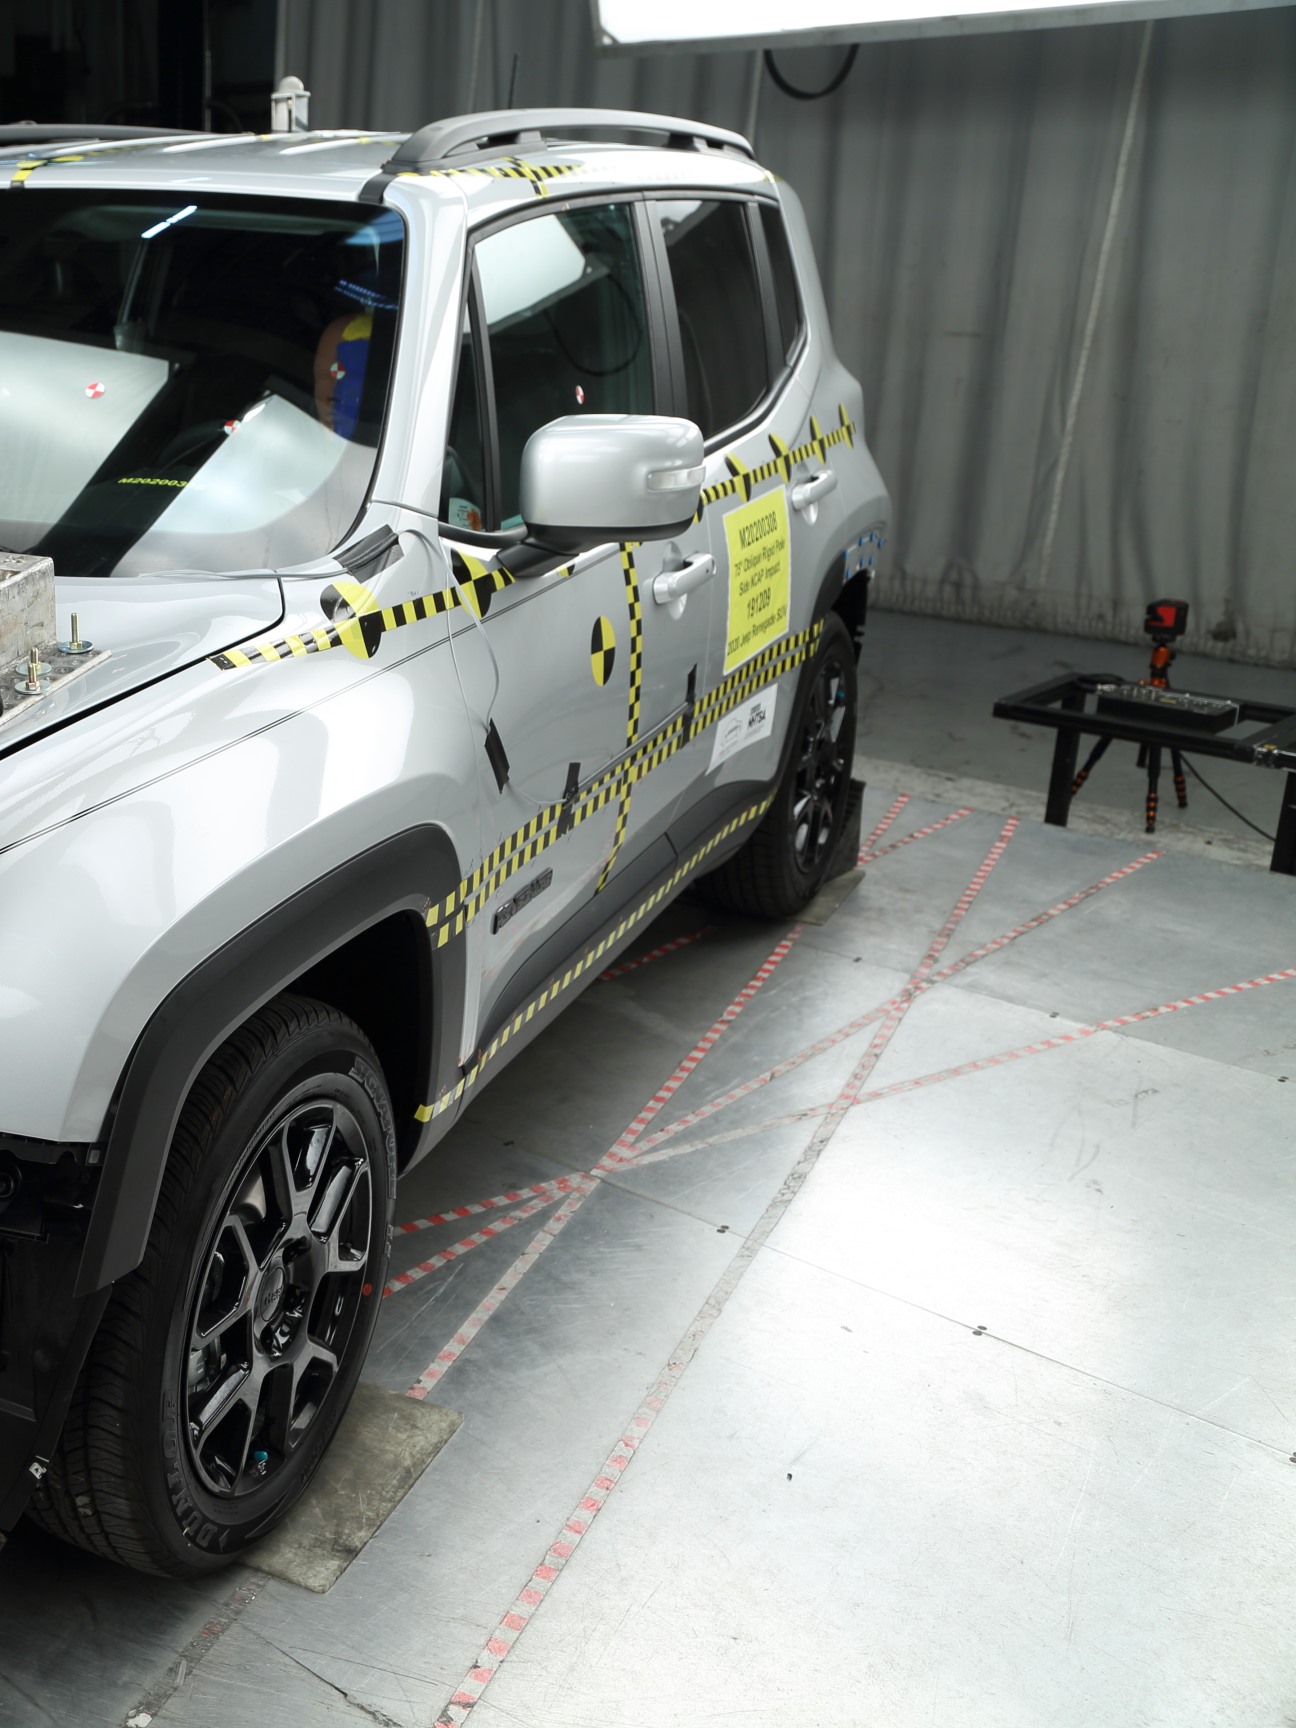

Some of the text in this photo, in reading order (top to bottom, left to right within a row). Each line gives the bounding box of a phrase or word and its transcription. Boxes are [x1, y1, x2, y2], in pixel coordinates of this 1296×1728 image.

[118, 477, 188, 488] M202003
[739, 511, 778, 549] M20200308
[747, 587, 771, 620] 191209
